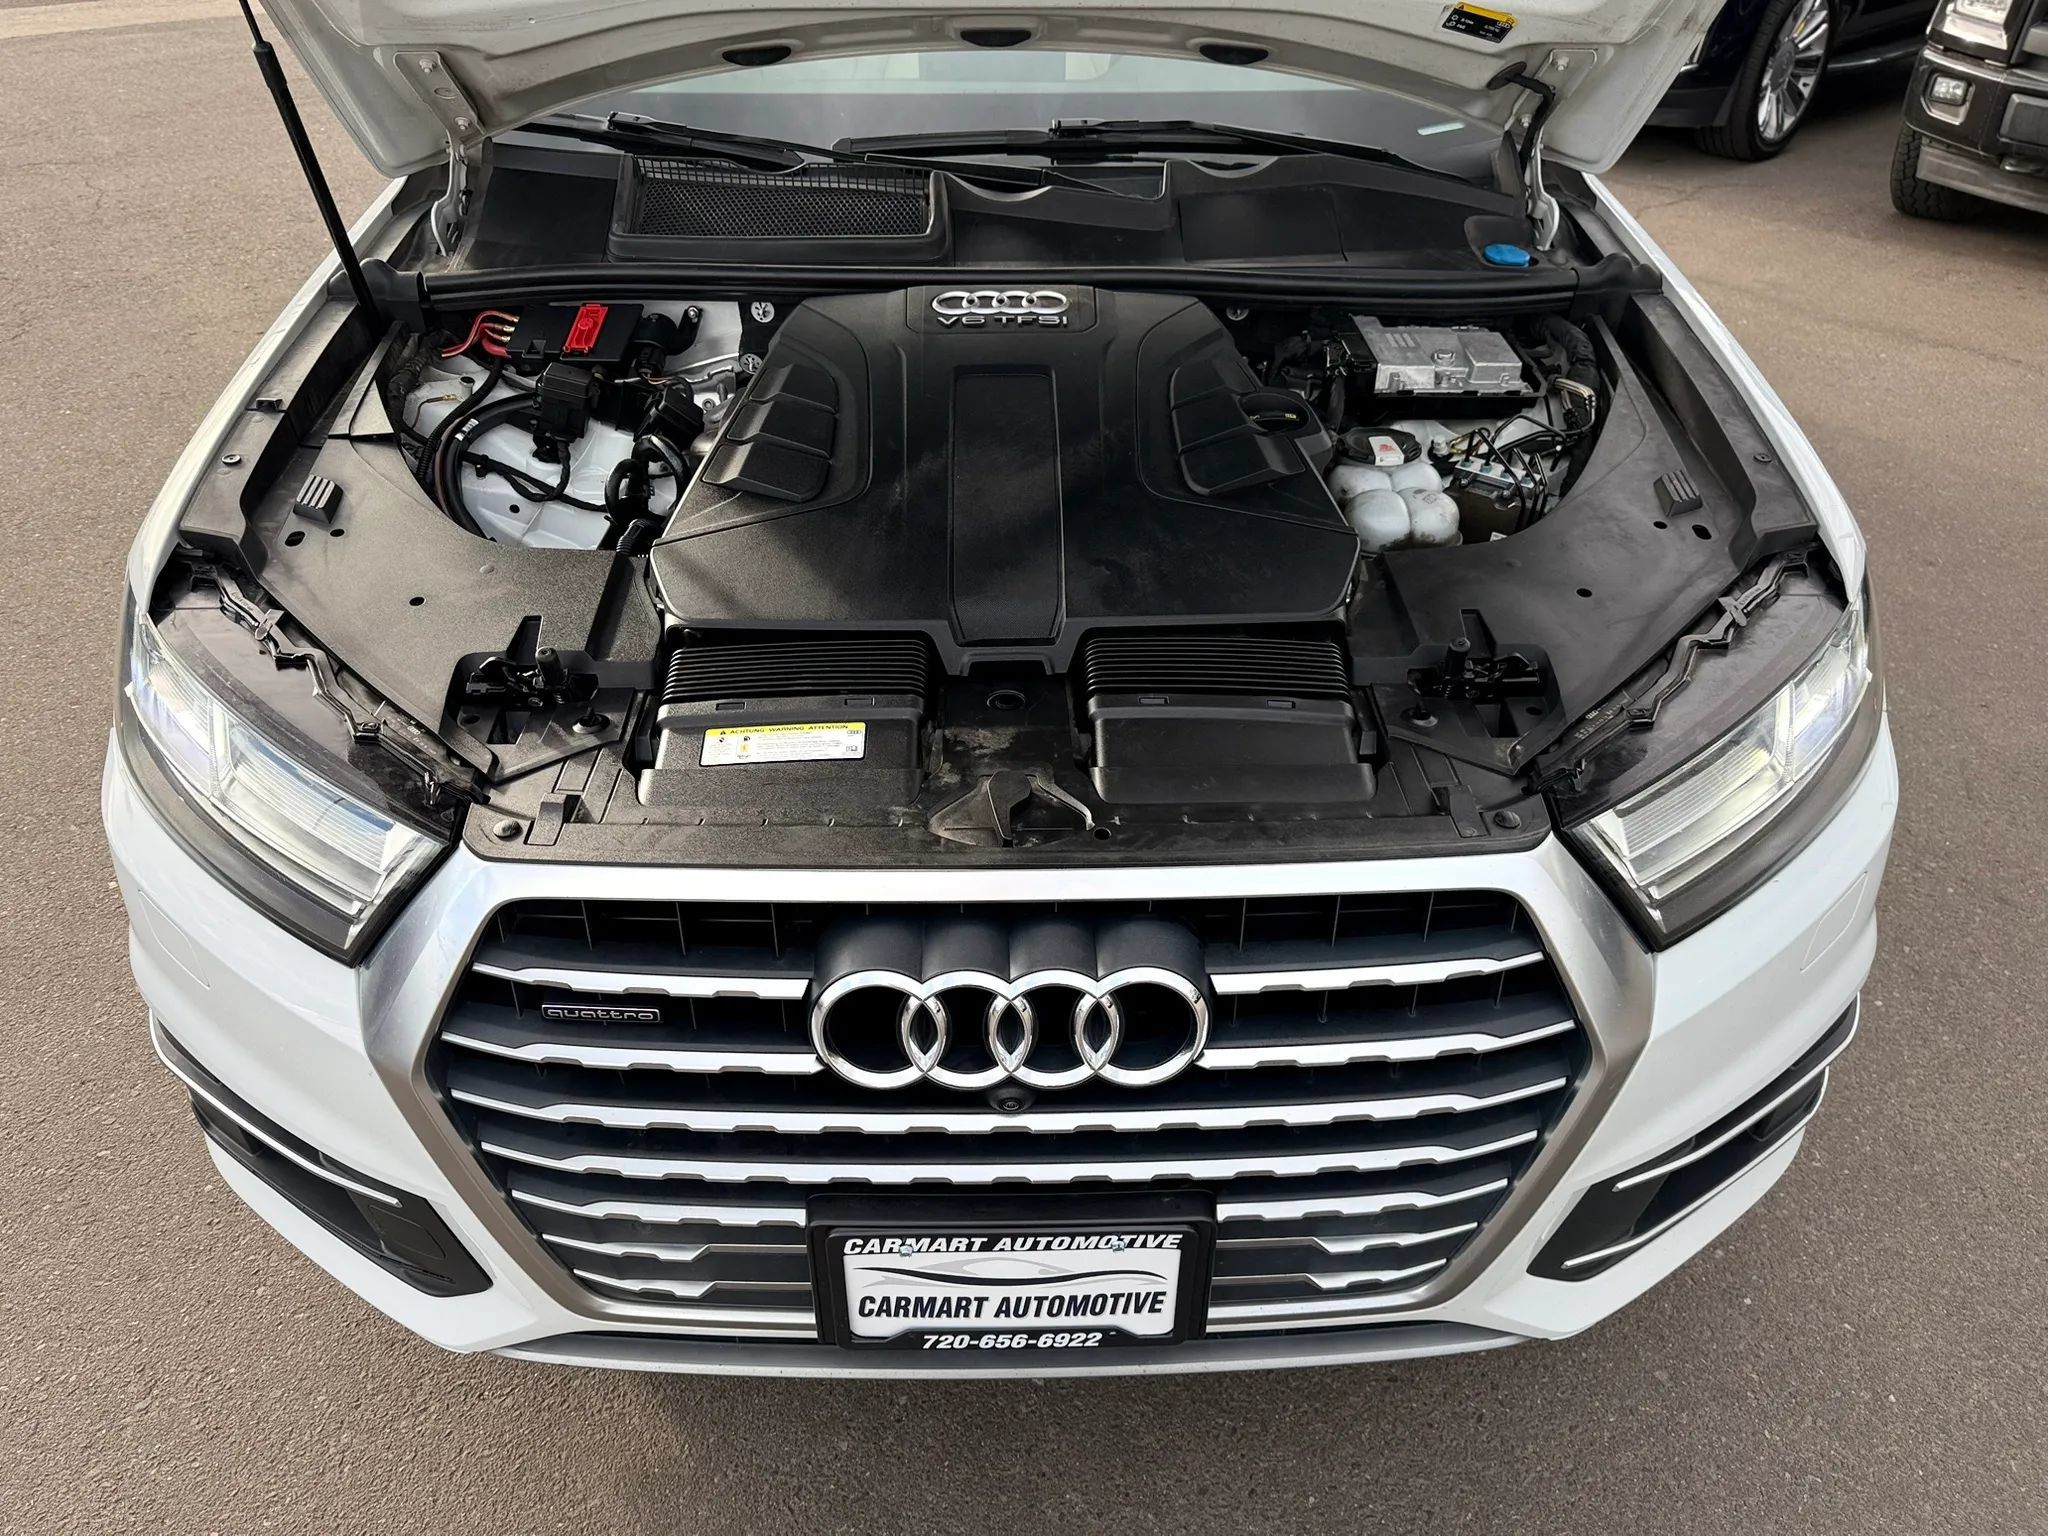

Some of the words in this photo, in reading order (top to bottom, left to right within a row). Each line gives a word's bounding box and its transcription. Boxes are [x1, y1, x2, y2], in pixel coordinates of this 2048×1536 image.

[938, 315, 986, 326] V6
[994, 315, 1068, 326] TFSI
[547, 1009, 654, 1020] quattro
[843, 1237, 988, 1255] CARMART
[992, 1234, 1183, 1252] AUTOMOTIVE
[858, 1295, 989, 1318] CARMART
[994, 1291, 1167, 1319] AUTOMOTIVE
[922, 1332, 1103, 1349] 720-656-6922
